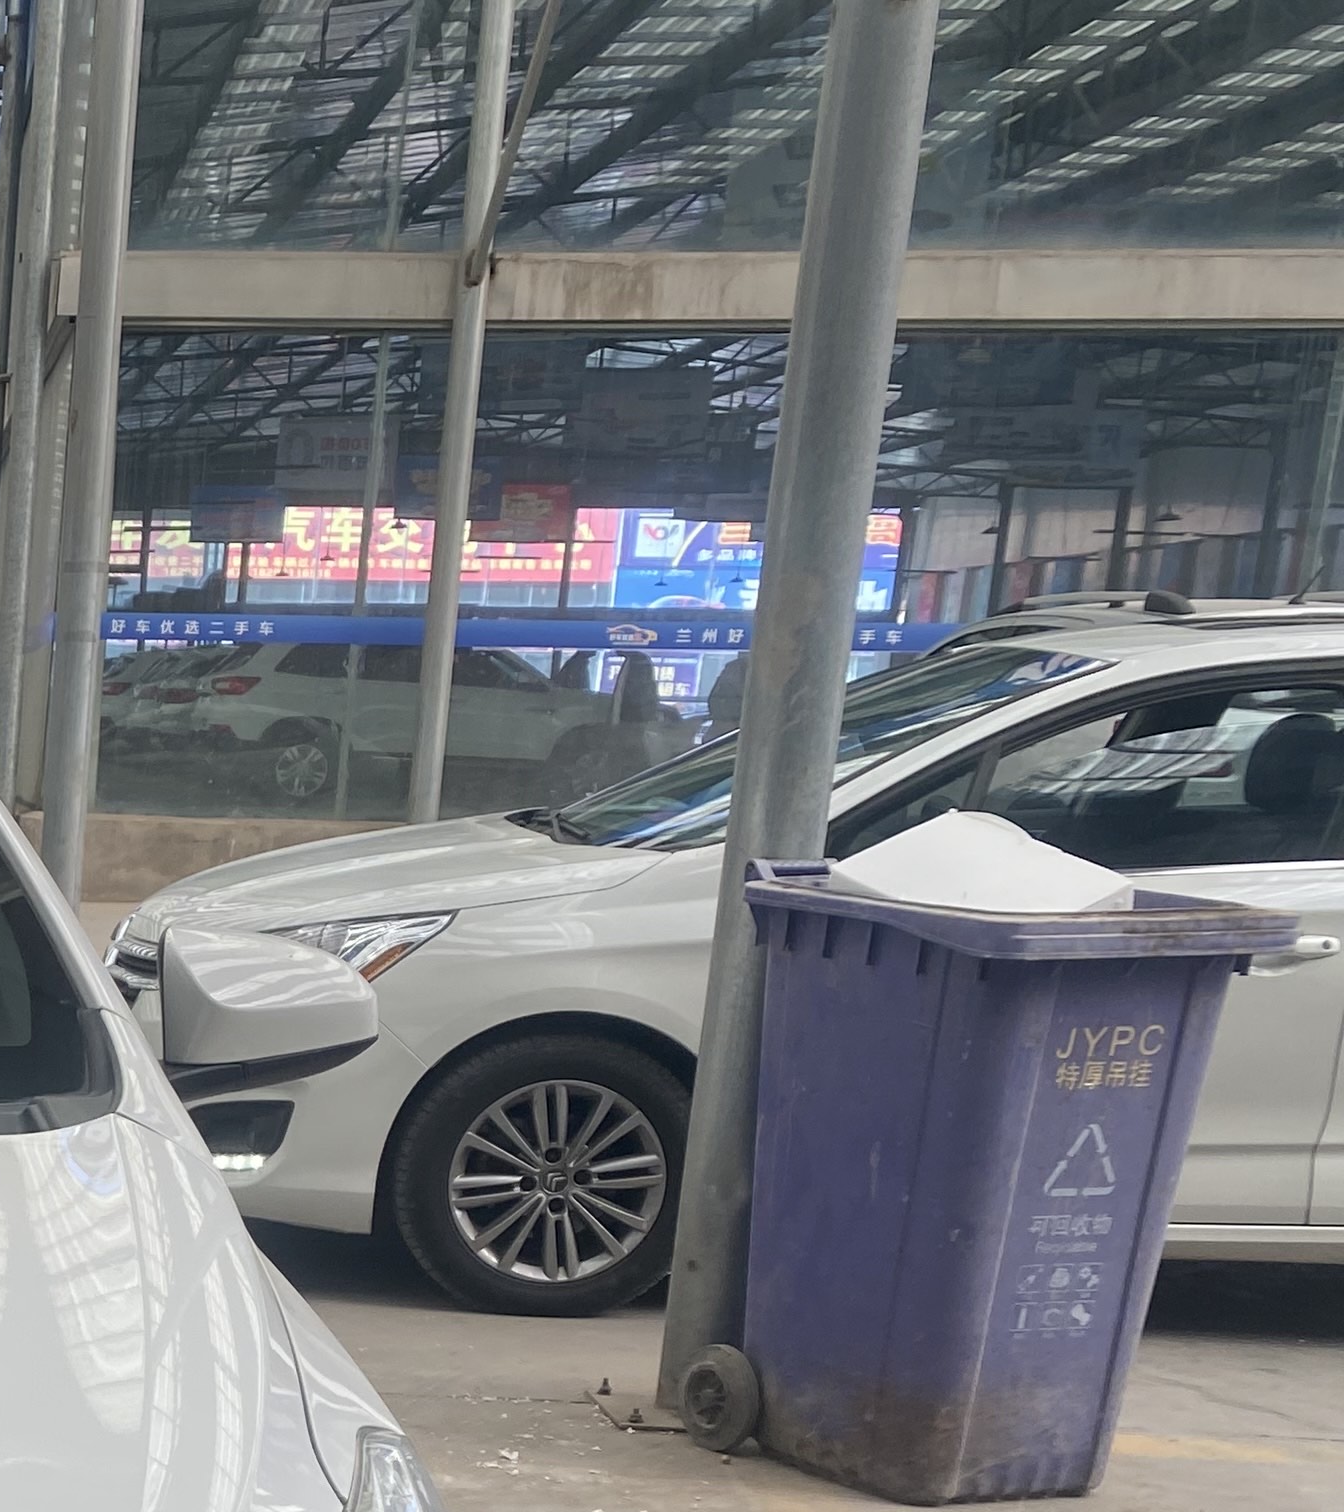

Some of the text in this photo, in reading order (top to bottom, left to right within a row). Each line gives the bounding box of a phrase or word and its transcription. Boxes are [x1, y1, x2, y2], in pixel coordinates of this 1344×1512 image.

[110, 619, 275, 637] 好车优选二手车
[1055, 1024, 1165, 1060] JYPC
[1055, 1060, 1154, 1091] 特厚吊挂
